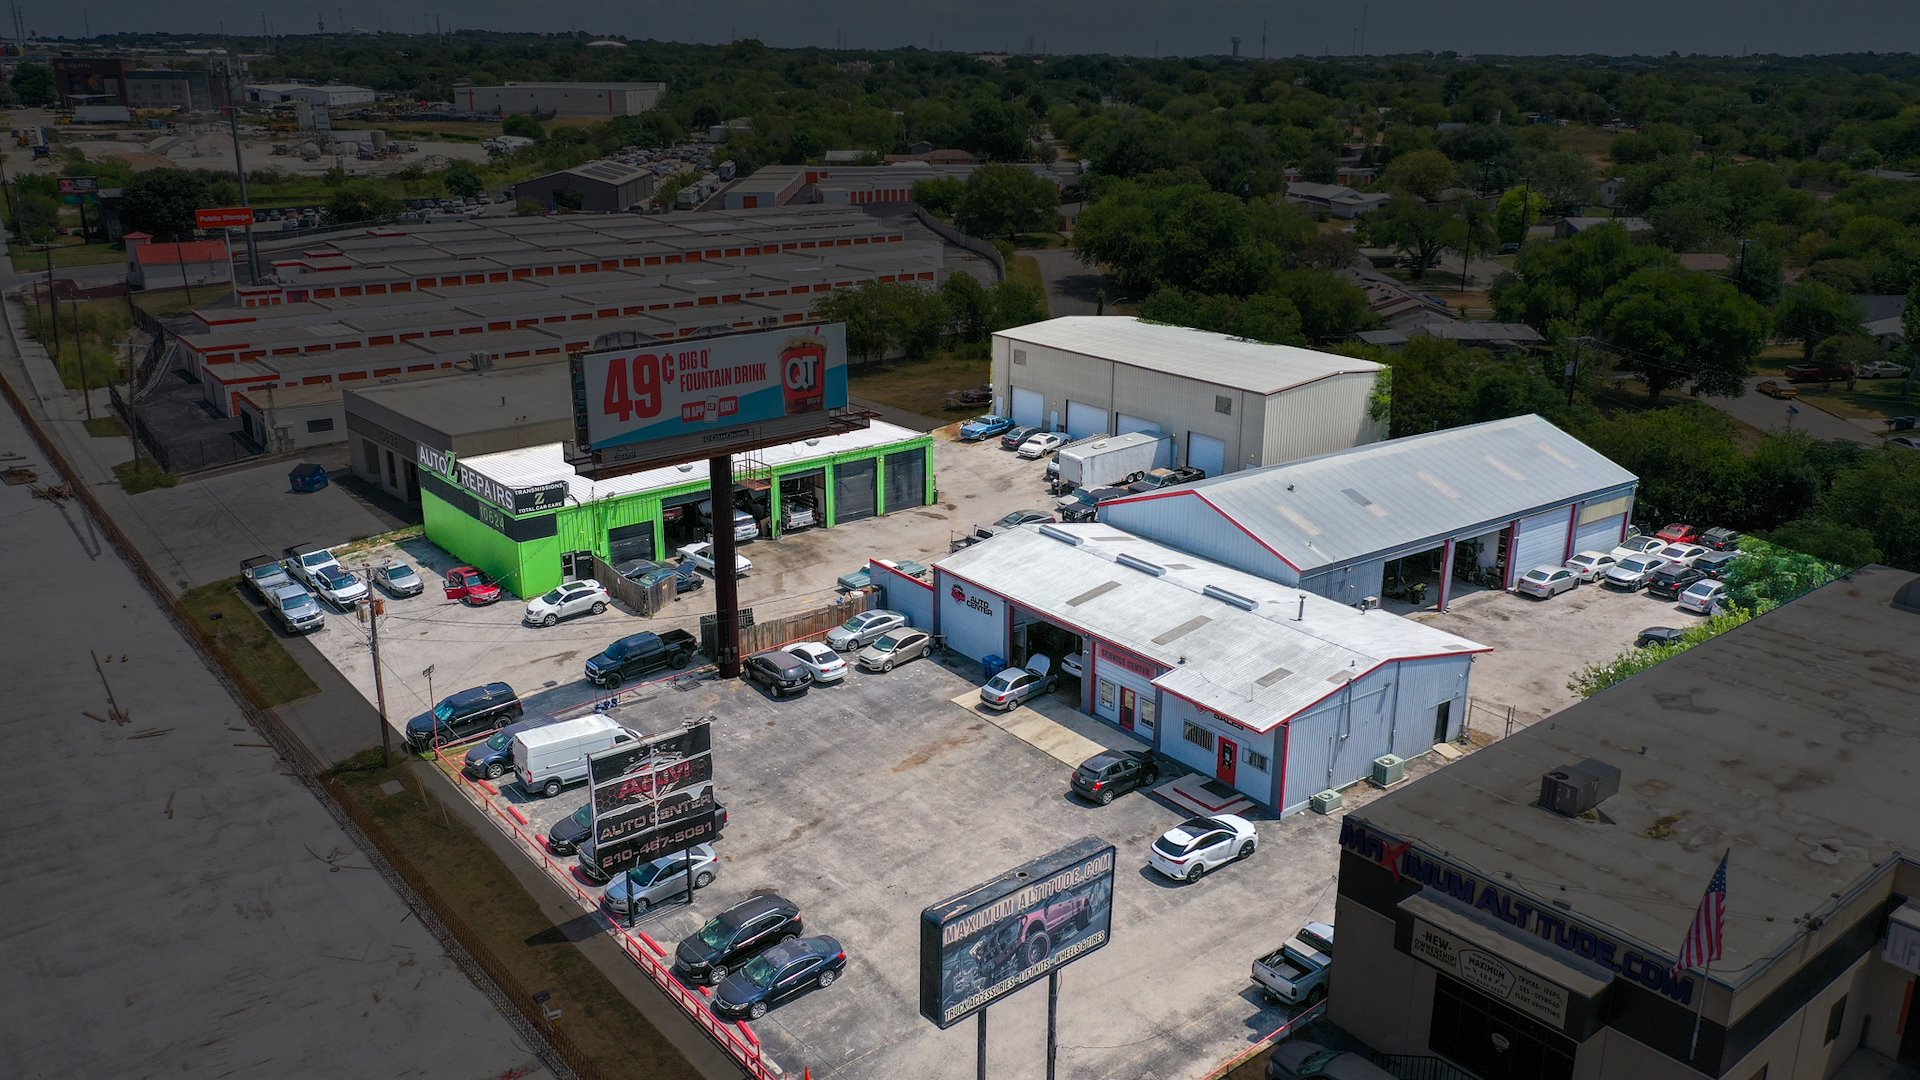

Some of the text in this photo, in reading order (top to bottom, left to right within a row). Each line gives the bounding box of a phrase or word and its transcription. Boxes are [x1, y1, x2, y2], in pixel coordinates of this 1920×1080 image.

[679, 352, 698, 371] BIG
[785, 355, 819, 391] QT
[680, 363, 767, 392] FOUNTAIN DRINK
[683, 405, 704, 419] IN APP
[720, 399, 736, 413] ONLY
[460, 467, 514, 510] REPAIRS
[514, 482, 564, 496] TRANSMISSIONS
[534, 492, 545, 505] Z
[479, 506, 505, 531] 10624
[518, 506, 536, 514] TOTAL
[548, 501, 563, 509] CARE
[966, 600, 993, 617] CENTER
[970, 596, 989, 608] AUTO
[1101, 648, 1150, 677] SERVICE CENTER
[600, 794, 712, 840] AUTO CENTER
[602, 821, 713, 868] 210-467-5091
[1339, 823, 1476, 905] MAXIMUM
[945, 853, 1111, 944] MAXIMUM ALTITUDE.COM
[945, 1002, 968, 1021] TRUCK
[968, 978, 1015, 1008] ACCESSORIES
[1019, 967, 1034, 983] LIFT
[1034, 959, 1050, 977] KITS
[1055, 945, 1080, 964] WHEELS
[1087, 931, 1105, 949] TIRES
[1468, 956, 1505, 980] MAXIMUM
[1518, 975, 1539, 989] TRUCKS
[1515, 992, 1530, 1004] FLEET
